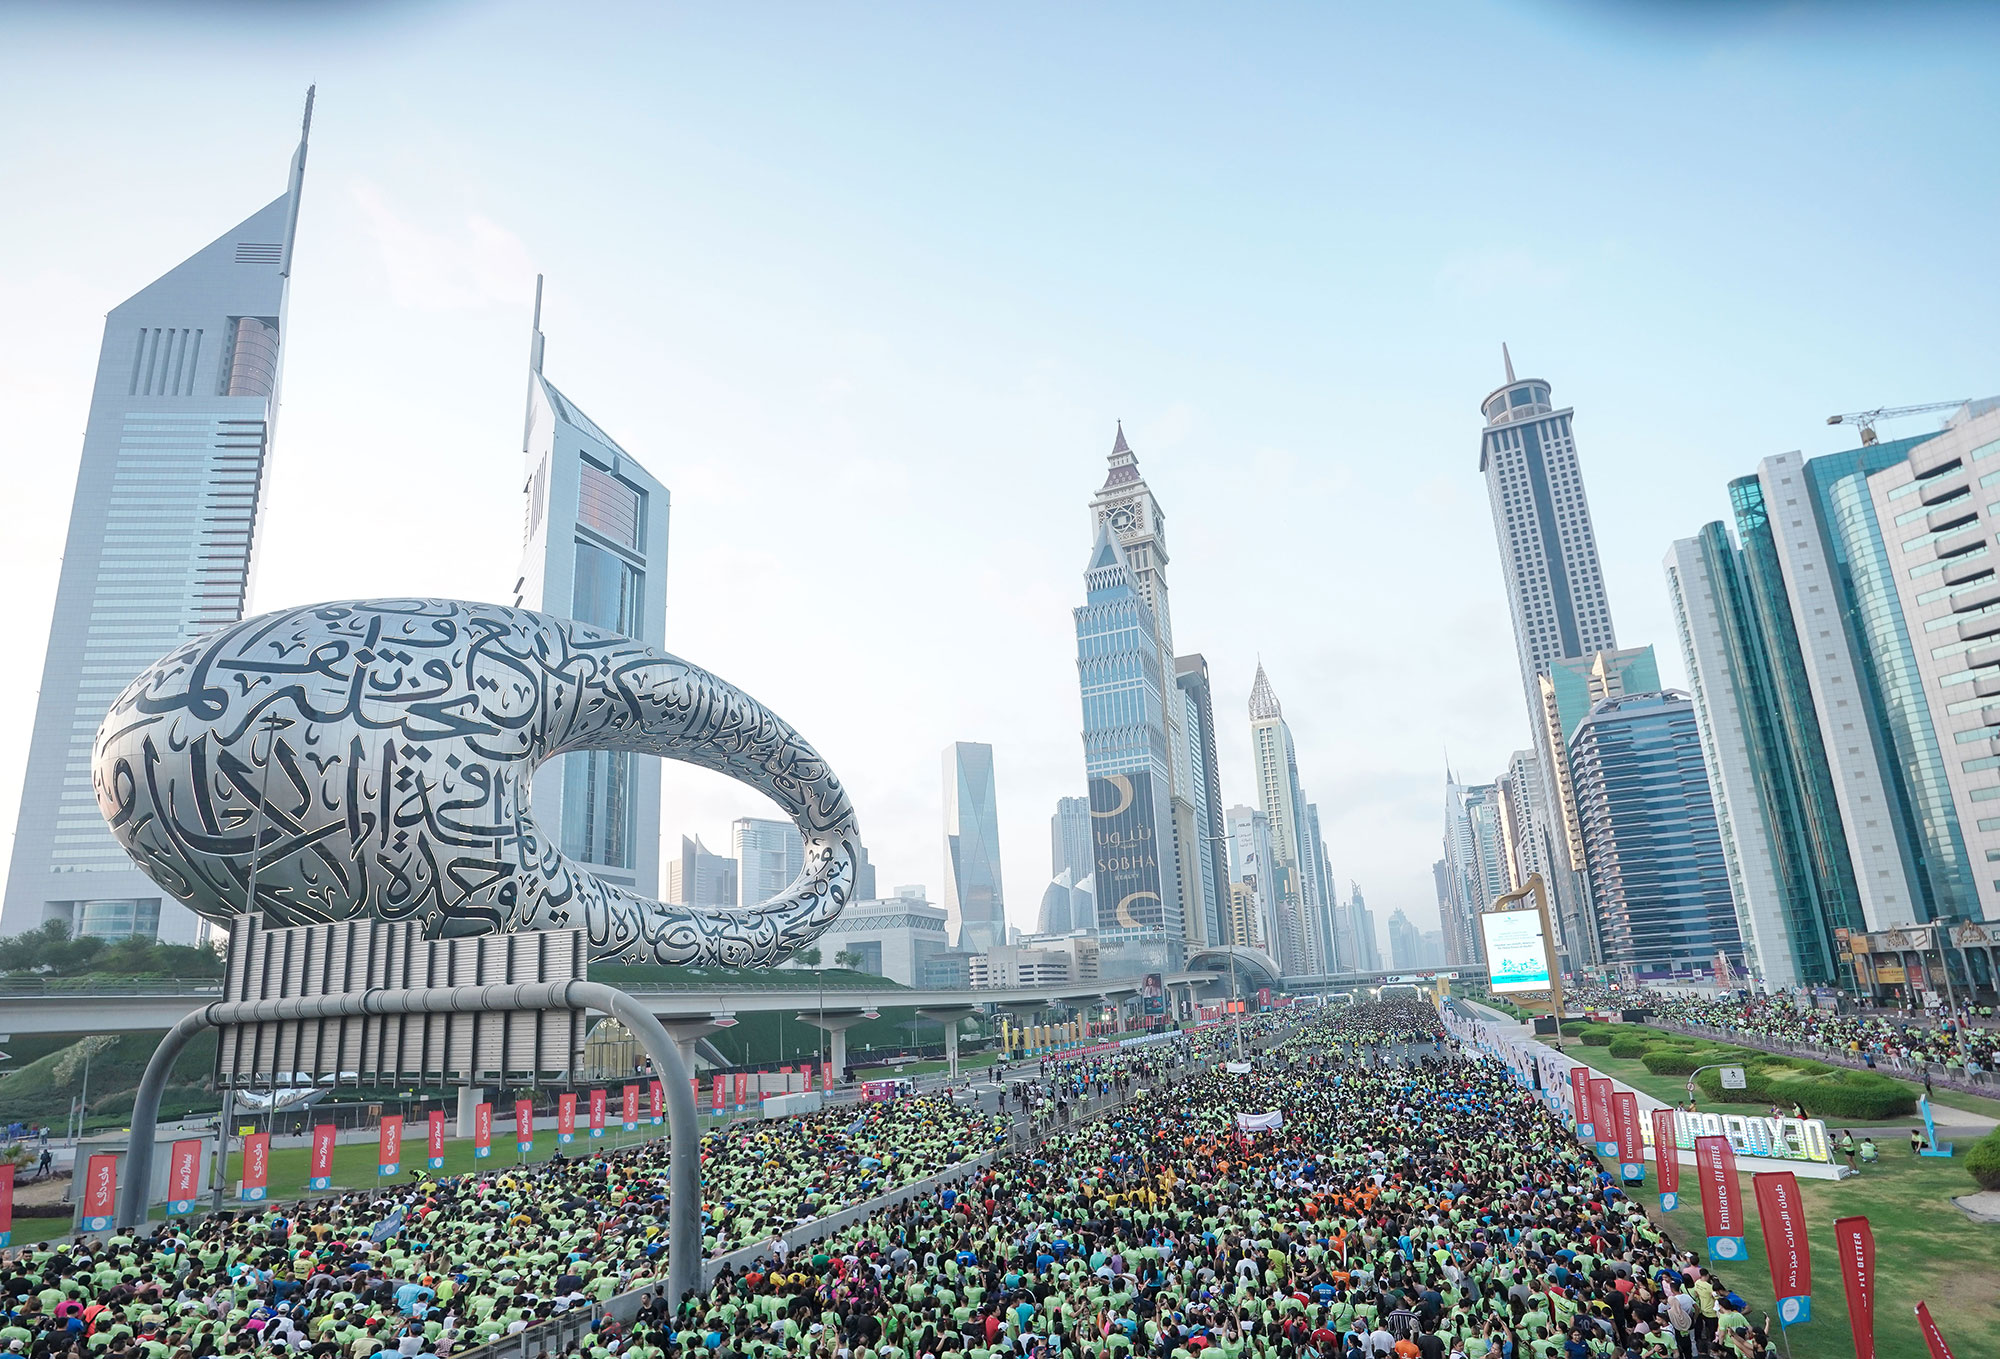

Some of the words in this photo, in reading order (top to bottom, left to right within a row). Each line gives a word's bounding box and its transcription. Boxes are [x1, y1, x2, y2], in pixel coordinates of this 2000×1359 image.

[1098, 855, 1155, 873] SOBHA
[1624, 1128, 1633, 1159] Emirates
[1638, 1109, 1831, 1162] #UBAI30X30
[180, 1153, 192, 1175] Dubai
[1710, 1145, 1722, 1169] BETTER
[180, 1174, 190, 1190] Mai
[1714, 1172, 1726, 1182] FLY
[1718, 1185, 1731, 1231] Emirates
[1775, 1184, 1788, 1209] طيران
[1853, 1232, 1864, 1268] BETTER
[1578, 1320, 1590, 1331] 10
